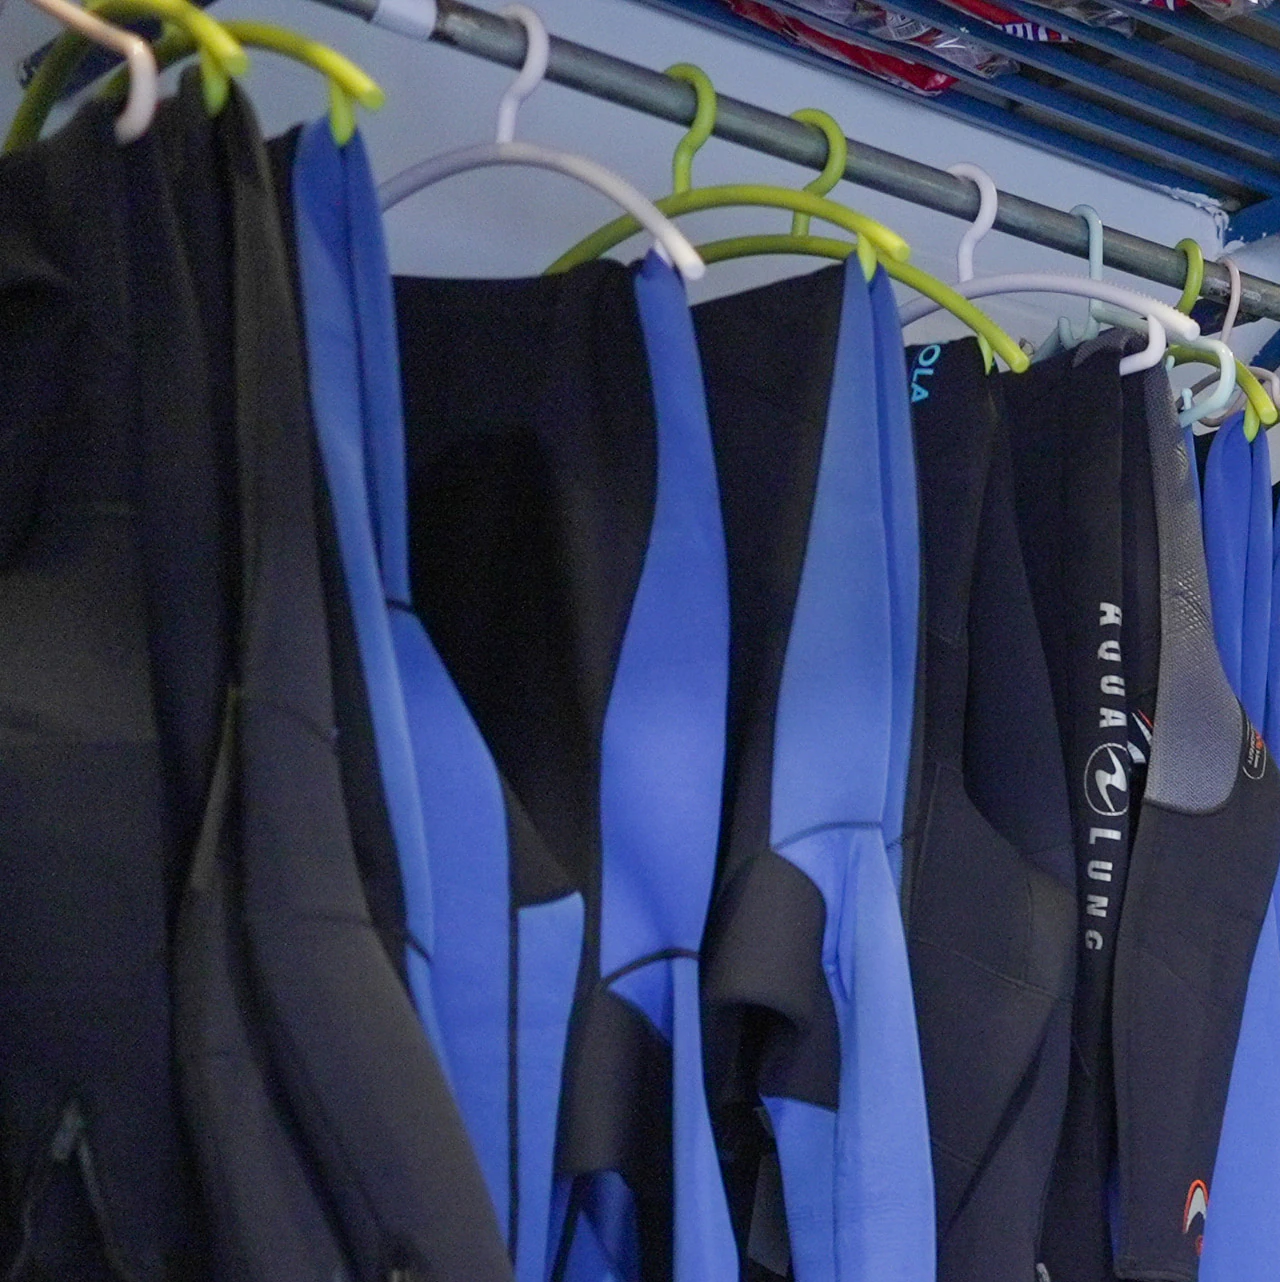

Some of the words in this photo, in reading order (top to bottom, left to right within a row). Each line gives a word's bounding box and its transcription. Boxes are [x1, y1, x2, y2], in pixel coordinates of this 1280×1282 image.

[911, 344, 941, 403] OLA
[1098, 602, 1128, 728] AQUA
[1084, 827, 1122, 951] LUNG
